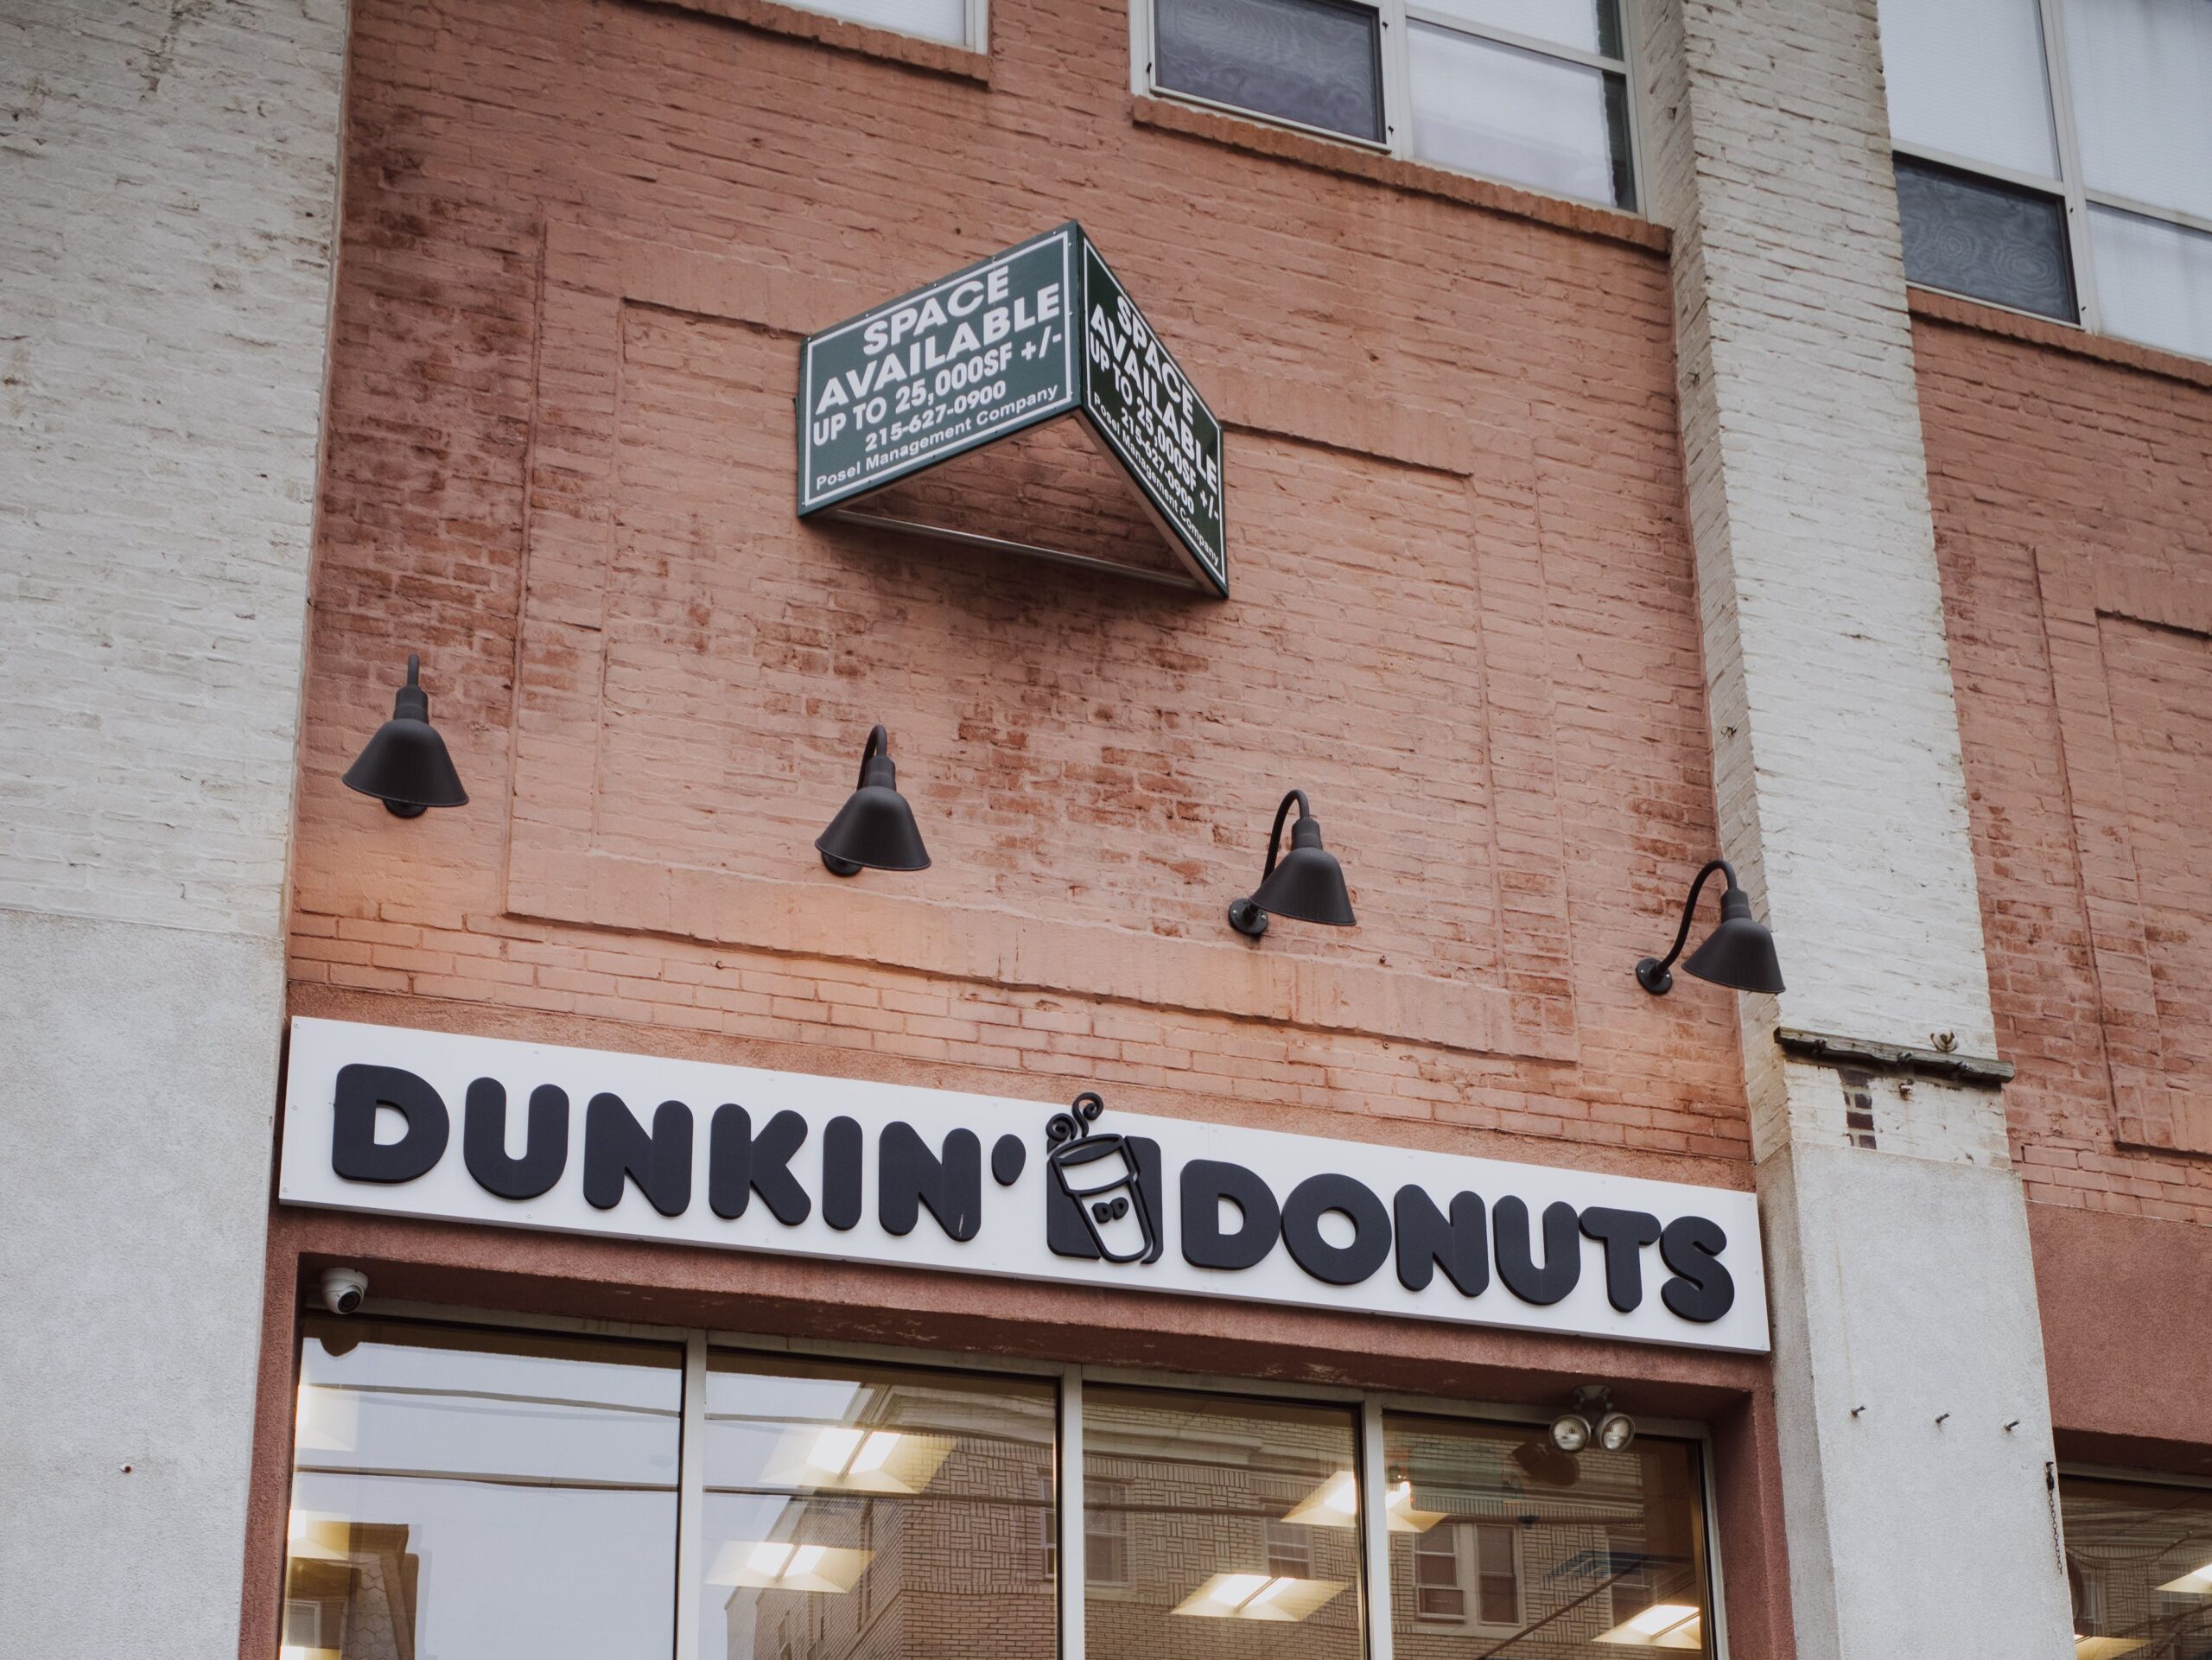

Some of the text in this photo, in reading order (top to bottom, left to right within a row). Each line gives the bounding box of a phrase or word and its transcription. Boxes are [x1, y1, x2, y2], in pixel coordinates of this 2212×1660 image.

[816, 283, 1059, 415] AVAILABLE
[863, 265, 1008, 355] SPACE
[1117, 296, 1193, 425] SPACE
[813, 326, 1061, 446] UP TO 25,000SF +/-
[817, 385, 1058, 490] Posel Management Company
[865, 380, 1006, 452] 215-627-0900
[1090, 303, 1217, 495] AVAILABLE
[1090, 331, 1110, 372] UP
[1113, 362, 1133, 406] TO
[1137, 397, 1197, 492] 25,000SF
[1094, 391, 1218, 567] Posel Management Company
[1122, 407, 1194, 514] 215-627-0900
[331, 1063, 1735, 1323] DUNKIN' DONUTS
[1091, 1197, 1129, 1224] DD
